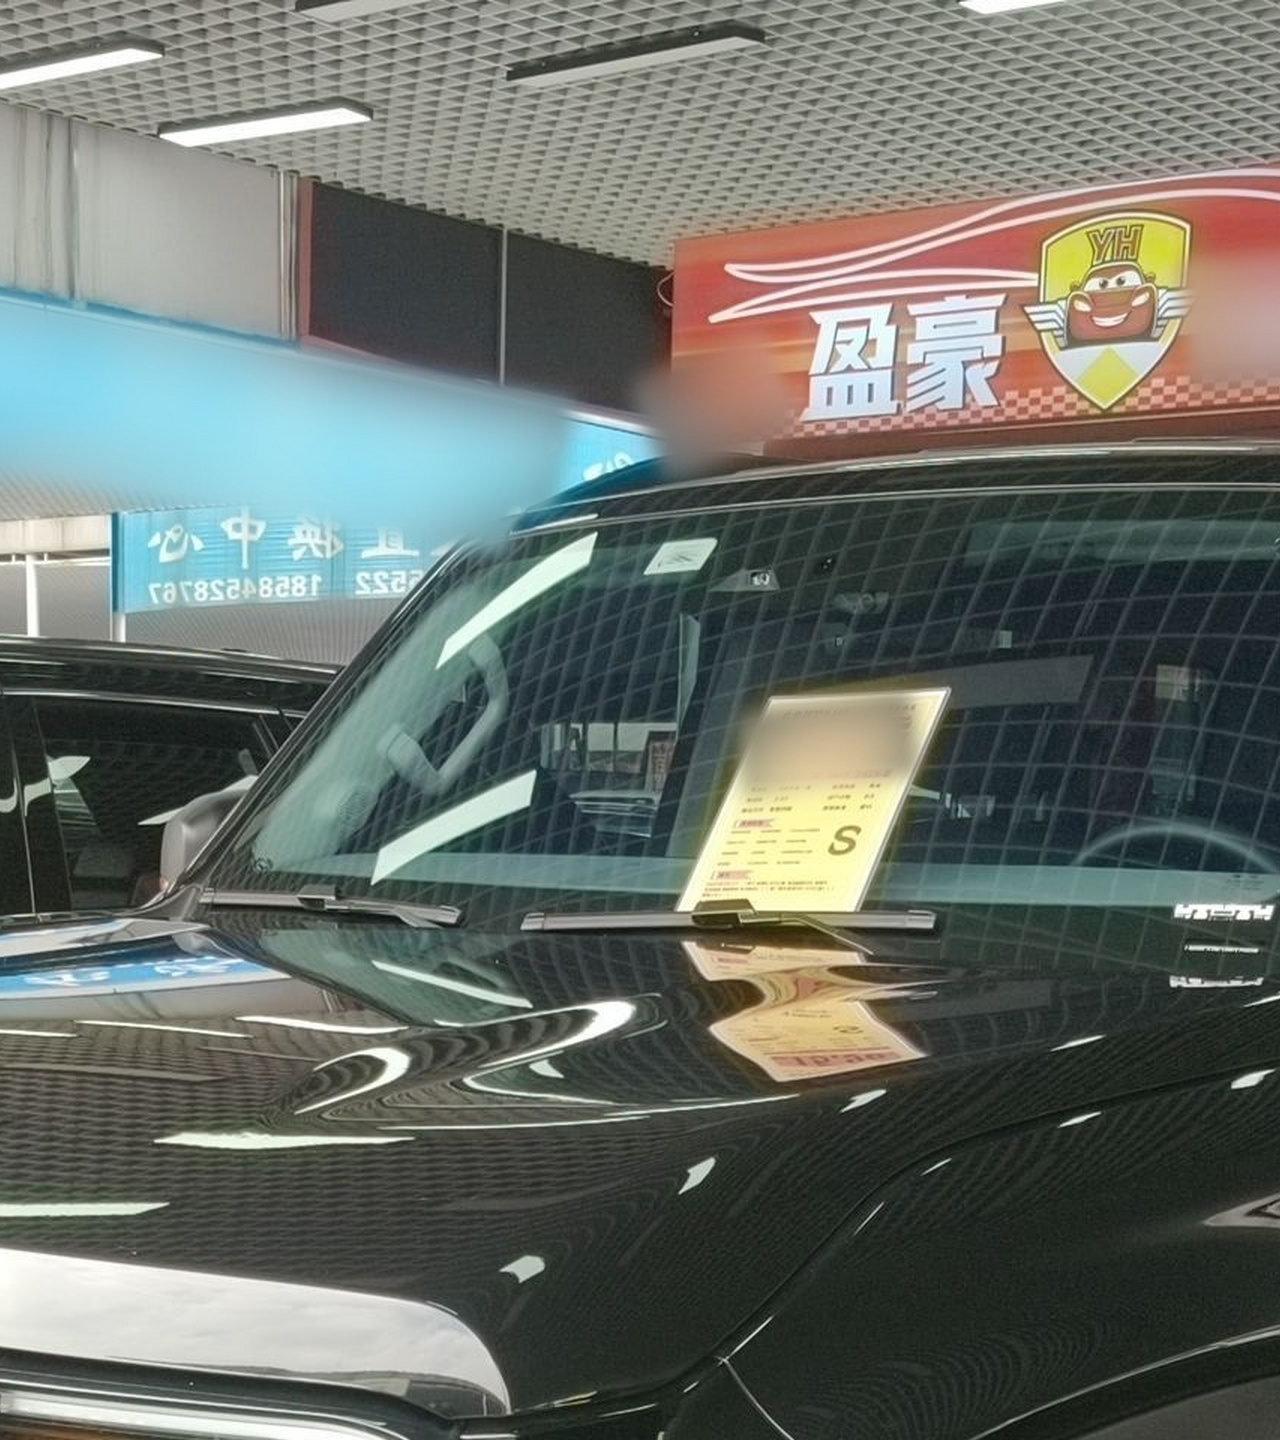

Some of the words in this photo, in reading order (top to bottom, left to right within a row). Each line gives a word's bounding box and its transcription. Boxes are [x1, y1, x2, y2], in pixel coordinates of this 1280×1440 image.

[1085, 224, 1144, 265] YH
[801, 294, 1008, 422] 盈豪
[827, 824, 862, 856] S
